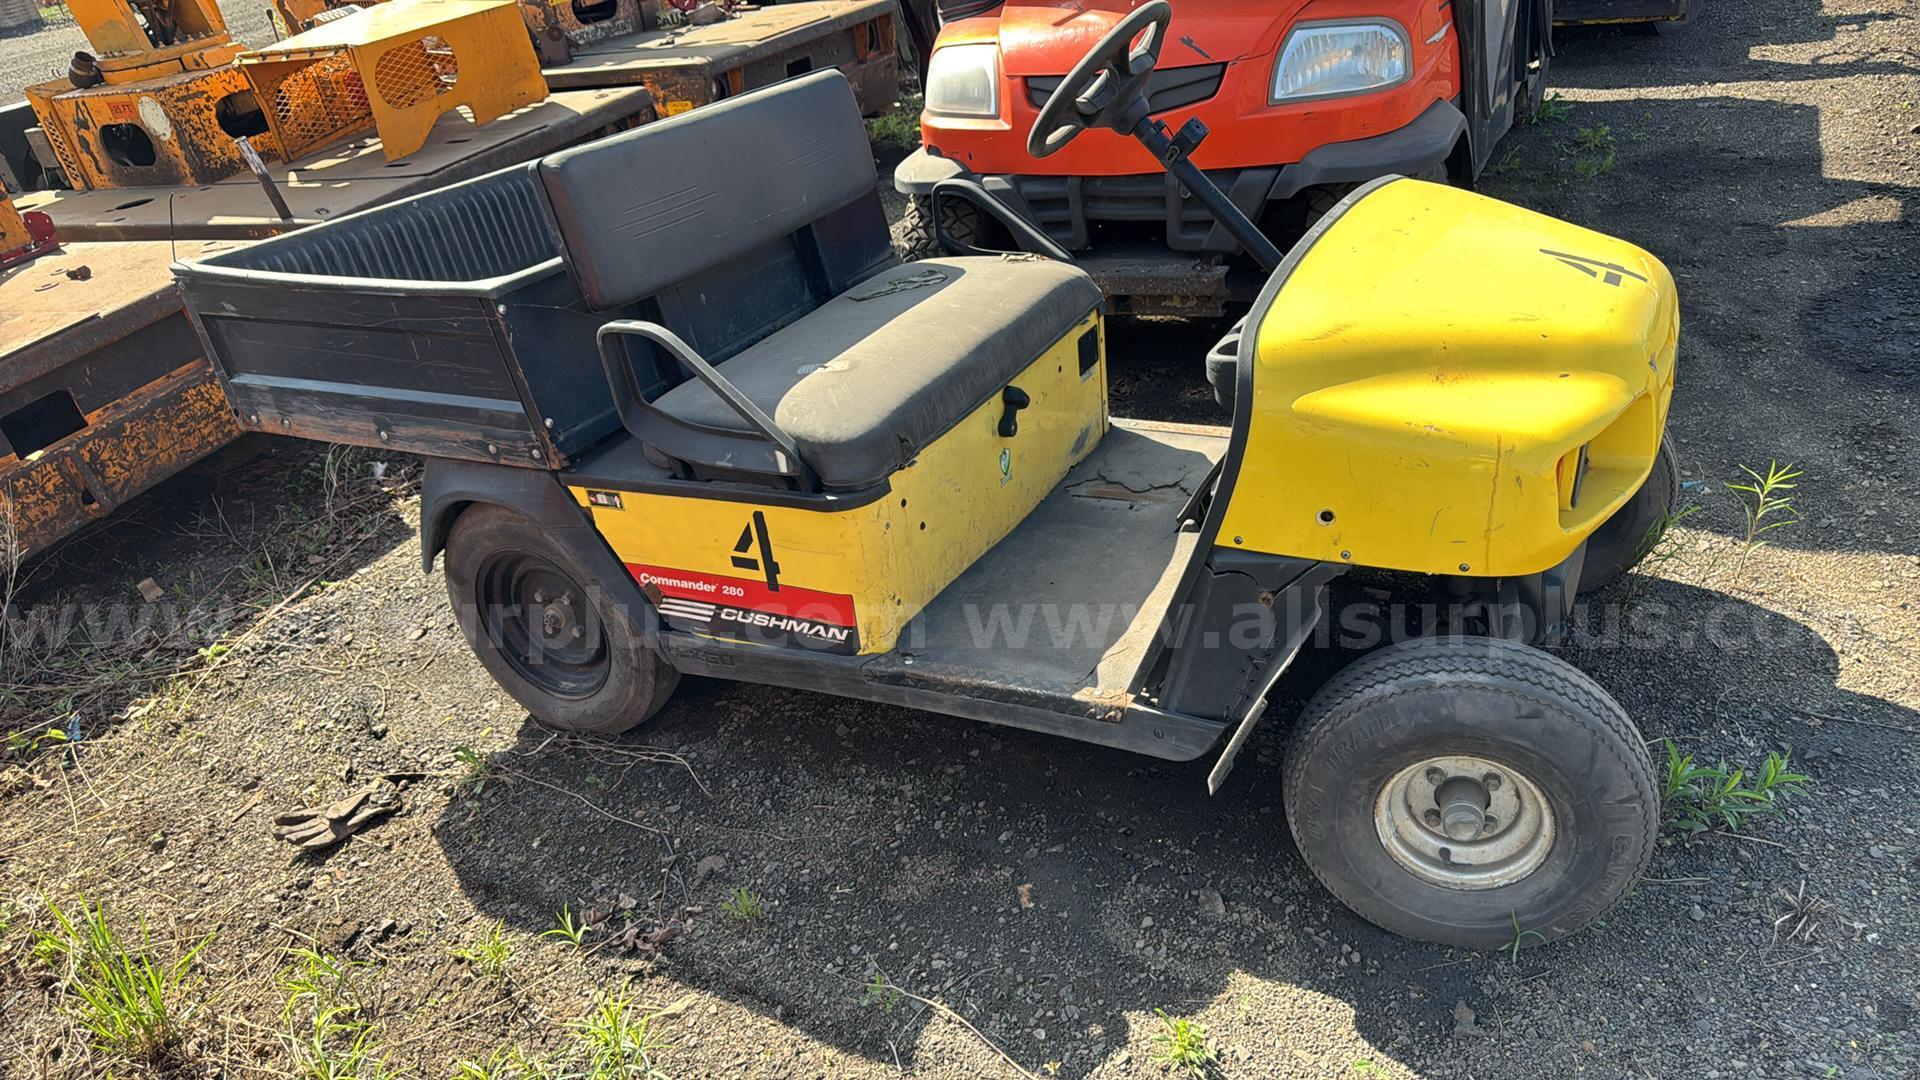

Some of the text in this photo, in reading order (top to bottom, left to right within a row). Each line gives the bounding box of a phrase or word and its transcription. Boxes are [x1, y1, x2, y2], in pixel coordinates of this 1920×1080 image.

[1539, 248, 1648, 287] 4
[730, 510, 781, 592] 4
[640, 573, 744, 597] Commander 280
[720, 608, 849, 640] CUSHMAN
